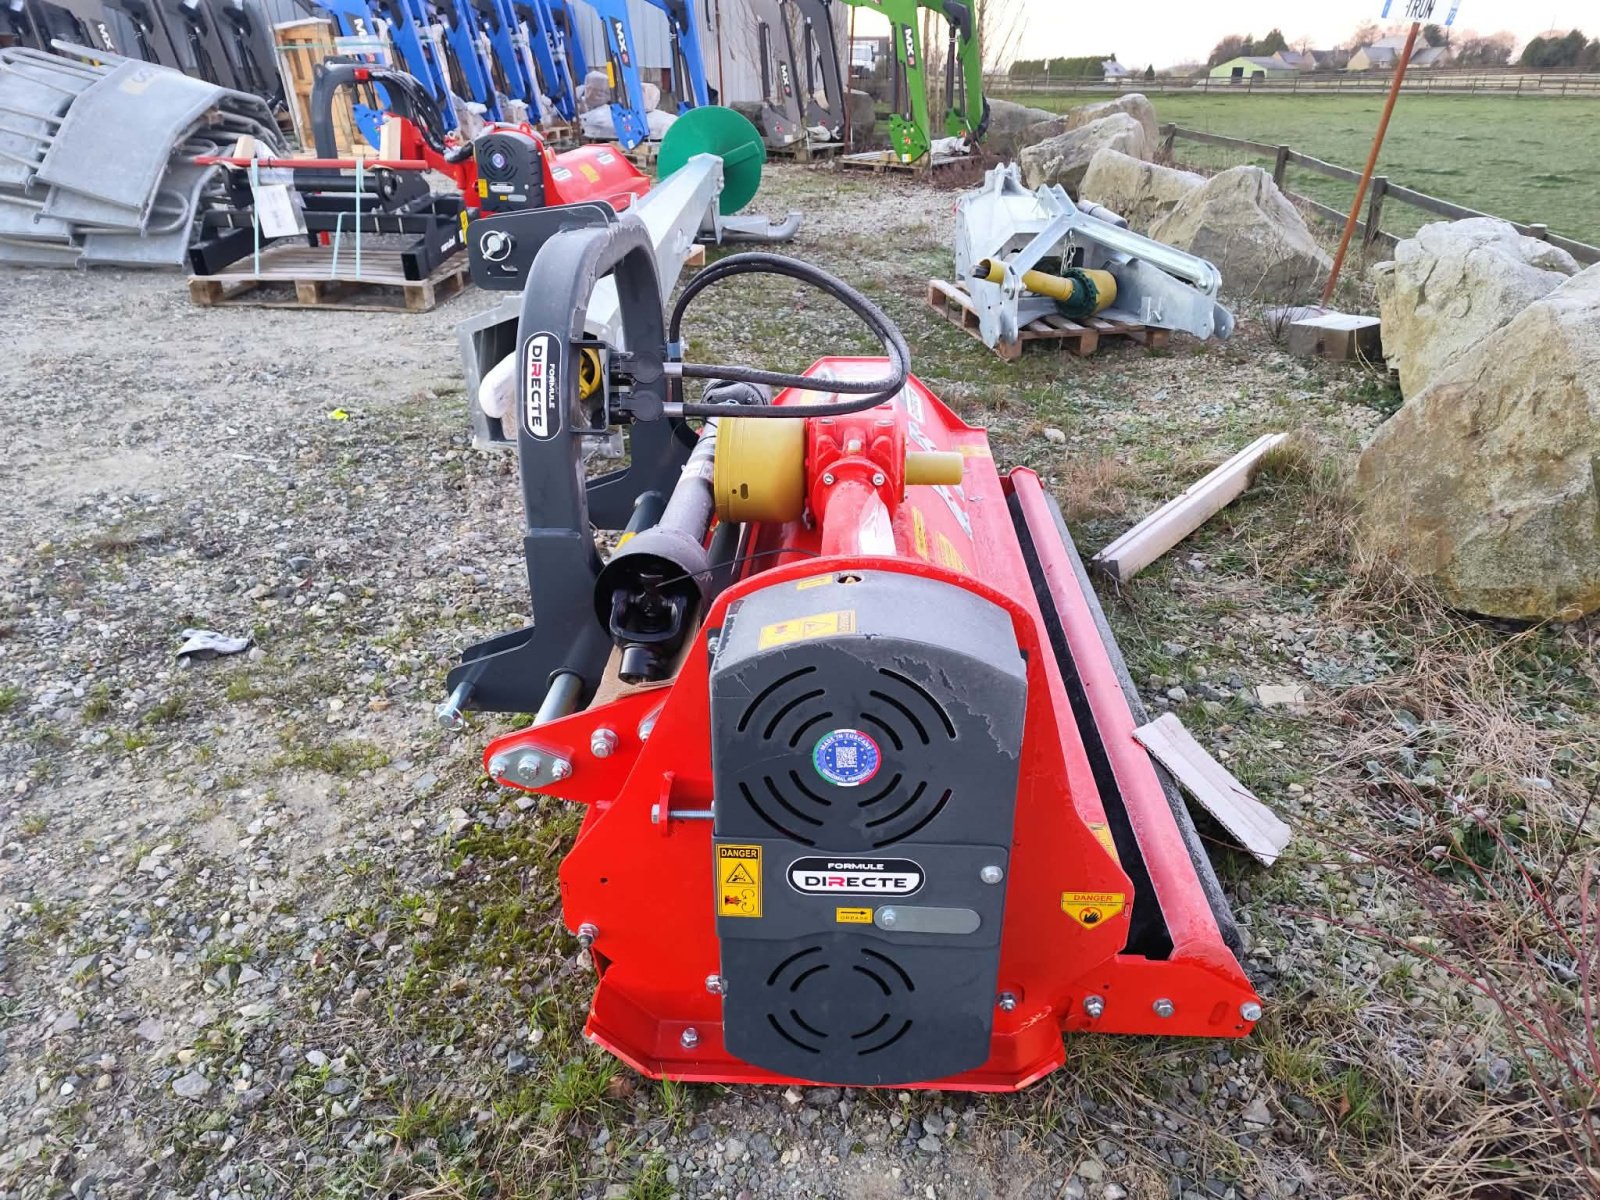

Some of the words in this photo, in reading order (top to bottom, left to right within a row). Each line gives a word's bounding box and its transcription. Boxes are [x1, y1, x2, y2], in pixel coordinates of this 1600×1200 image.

[98, 24, 114, 49] MX
[615, 22, 627, 52] MX
[904, 28, 915, 56] MX
[781, 64, 790, 86] MX
[531, 345, 543, 427] DIRECTE
[548, 363, 556, 409] FORMULE
[720, 849, 758, 858] DANGER
[827, 862, 885, 871] FORMULE
[804, 876, 908, 889] DIRECTE
[1073, 894, 1113, 902] DANGER
